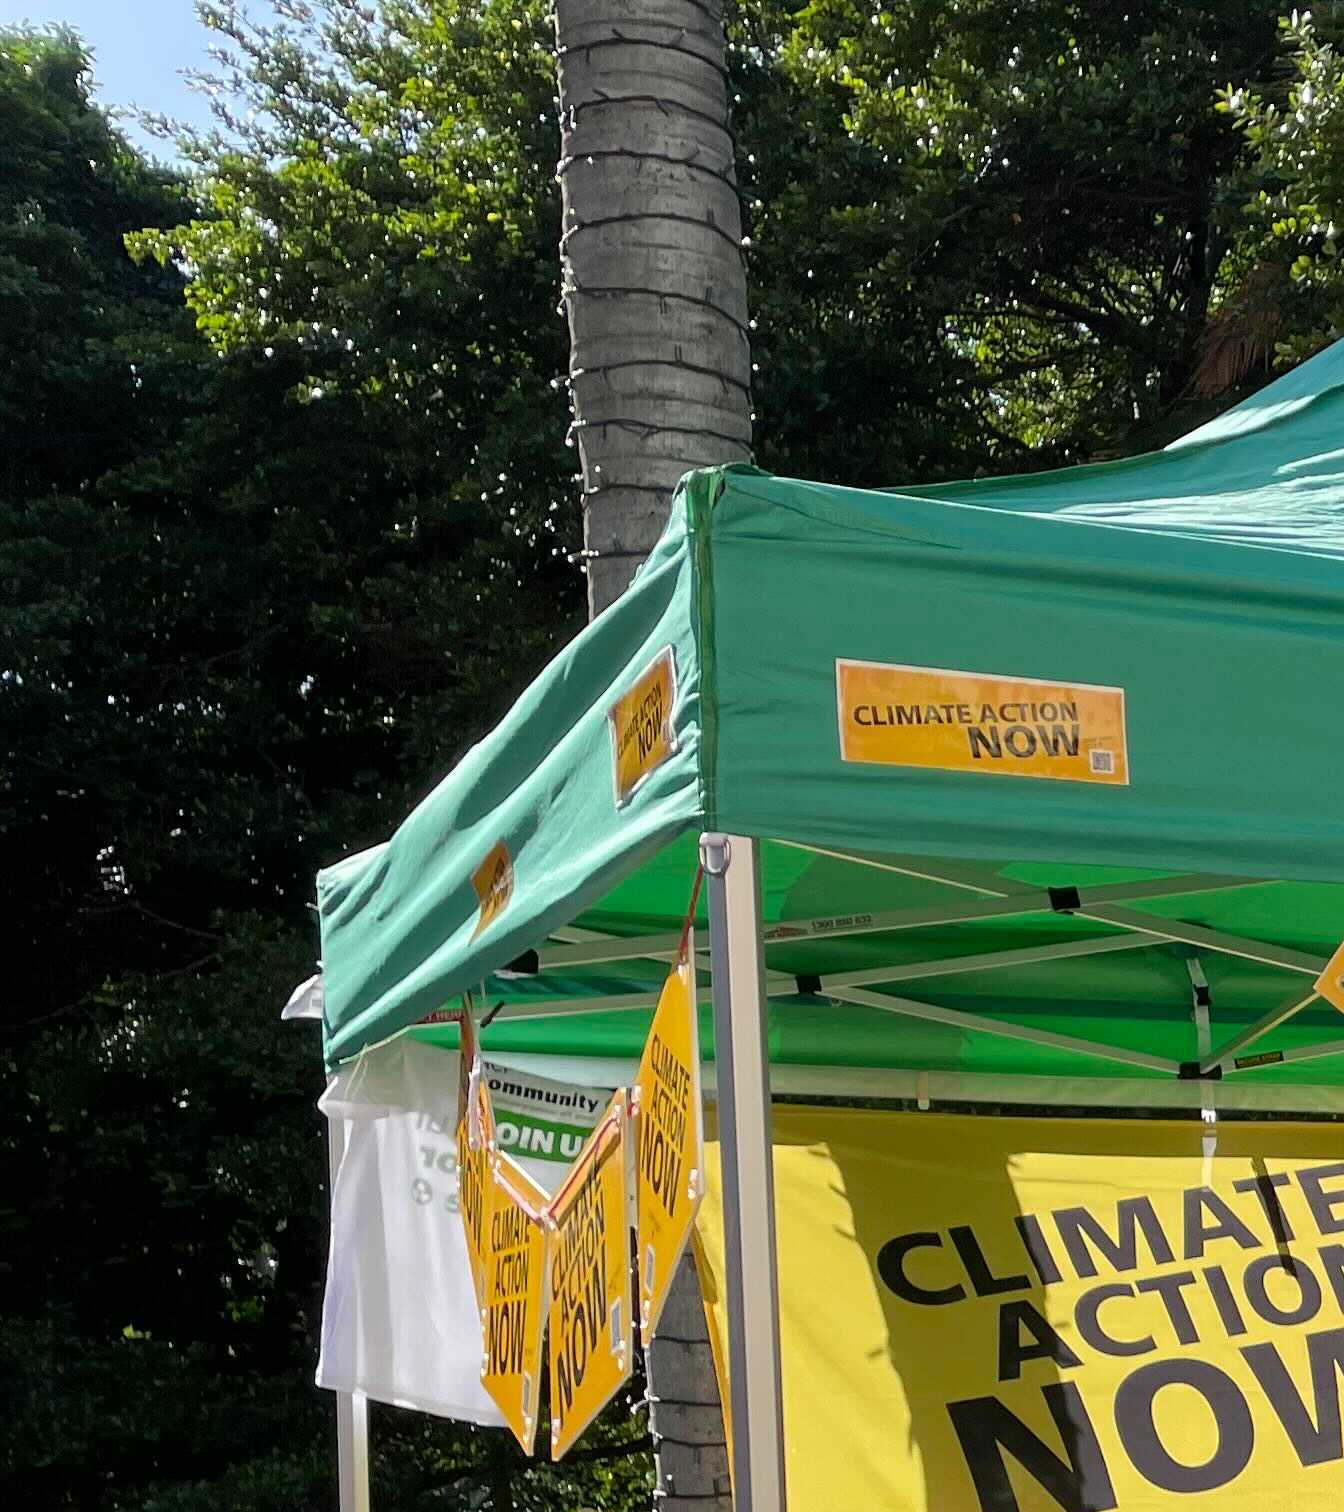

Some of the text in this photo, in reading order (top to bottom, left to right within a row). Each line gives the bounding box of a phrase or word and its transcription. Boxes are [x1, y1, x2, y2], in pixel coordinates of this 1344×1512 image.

[638, 698, 662, 764] NOW
[854, 702, 1079, 726] CLIMATE ACTION
[967, 724, 1080, 759] NOW
[488, 1079, 599, 1113] ommunity
[651, 1033, 690, 1111] CLIMATE
[495, 1121, 555, 1153] OIN
[651, 1078, 687, 1154] ACTION
[641, 1111, 682, 1217] NOW
[492, 1205, 530, 1253] CLIMATE
[495, 1247, 530, 1298] ACTION
[561, 1192, 606, 1337] ACTION
[488, 1299, 527, 1376] NOW
[557, 1240, 607, 1431] NOW
